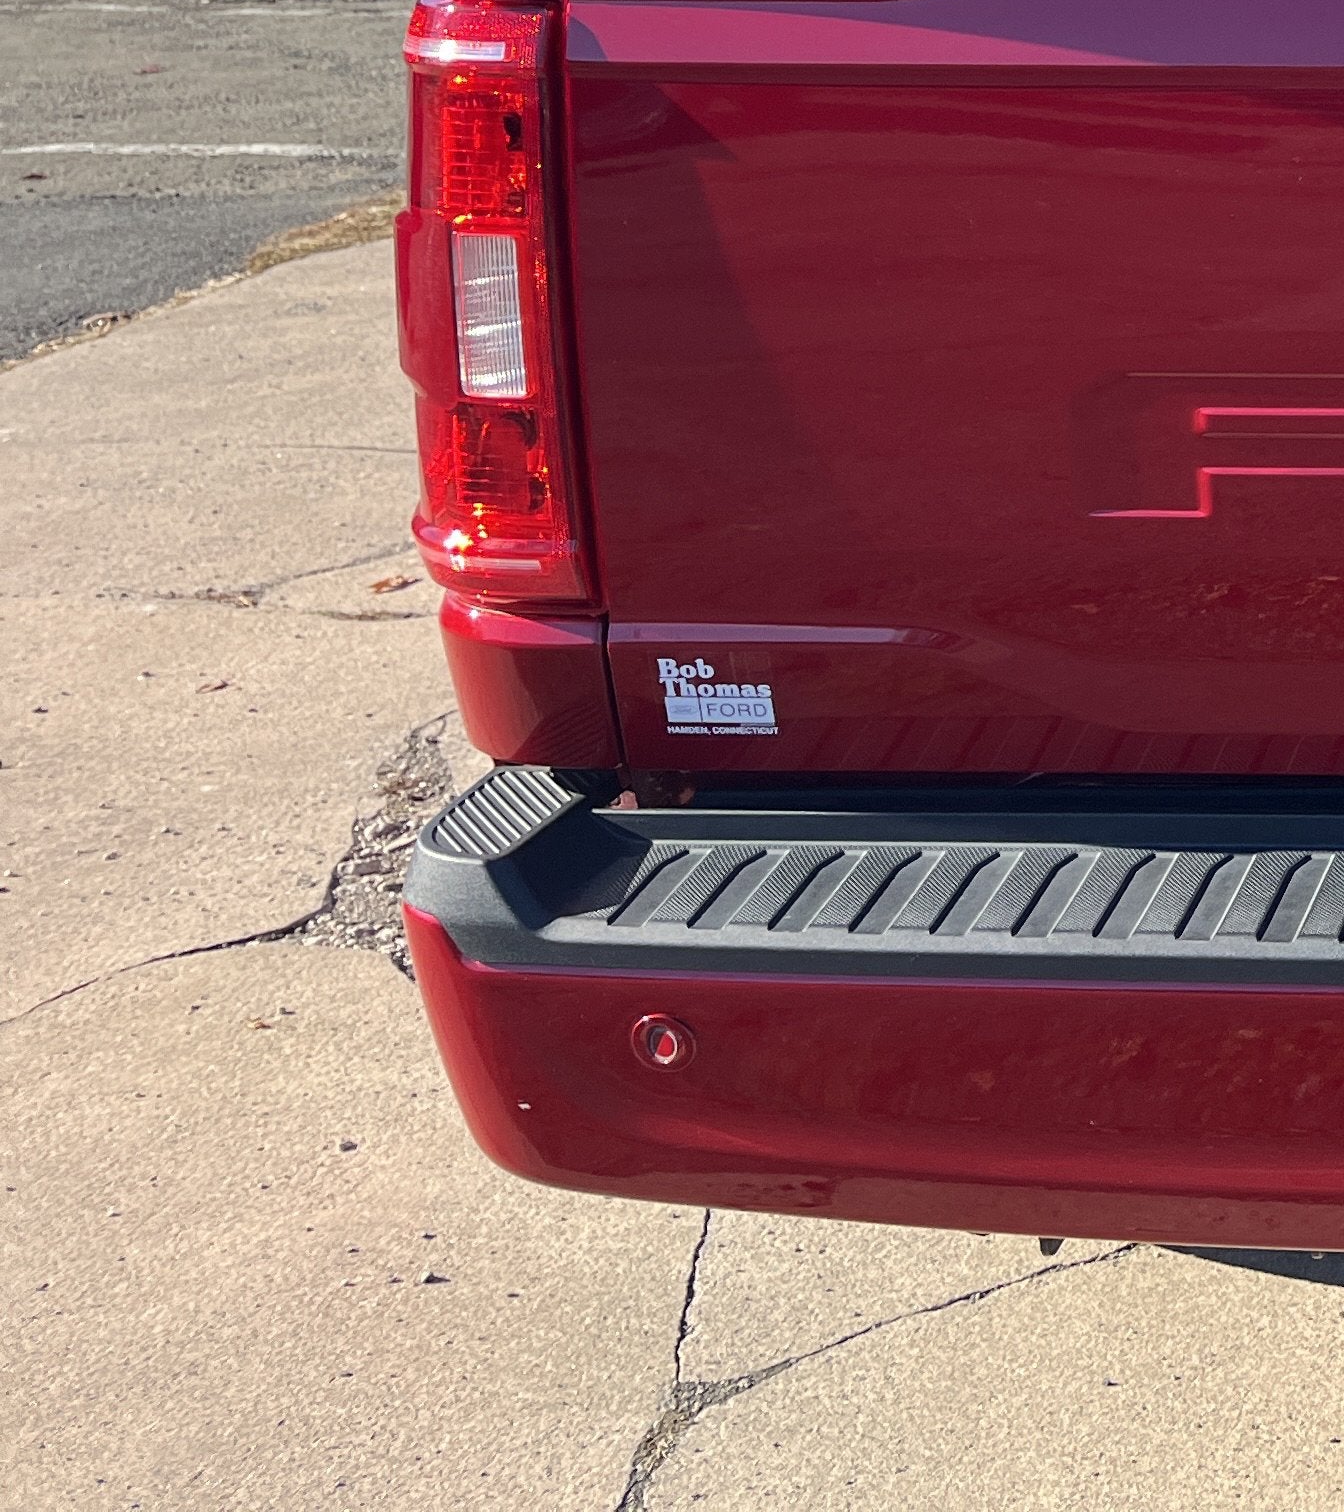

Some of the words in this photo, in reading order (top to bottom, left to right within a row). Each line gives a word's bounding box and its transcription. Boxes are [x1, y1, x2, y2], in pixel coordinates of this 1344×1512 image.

[657, 658, 715, 679] Bob
[659, 677, 772, 698] Thomas
[706, 703, 767, 717] FORD
[712, 726, 778, 735] CONNECTICUT
